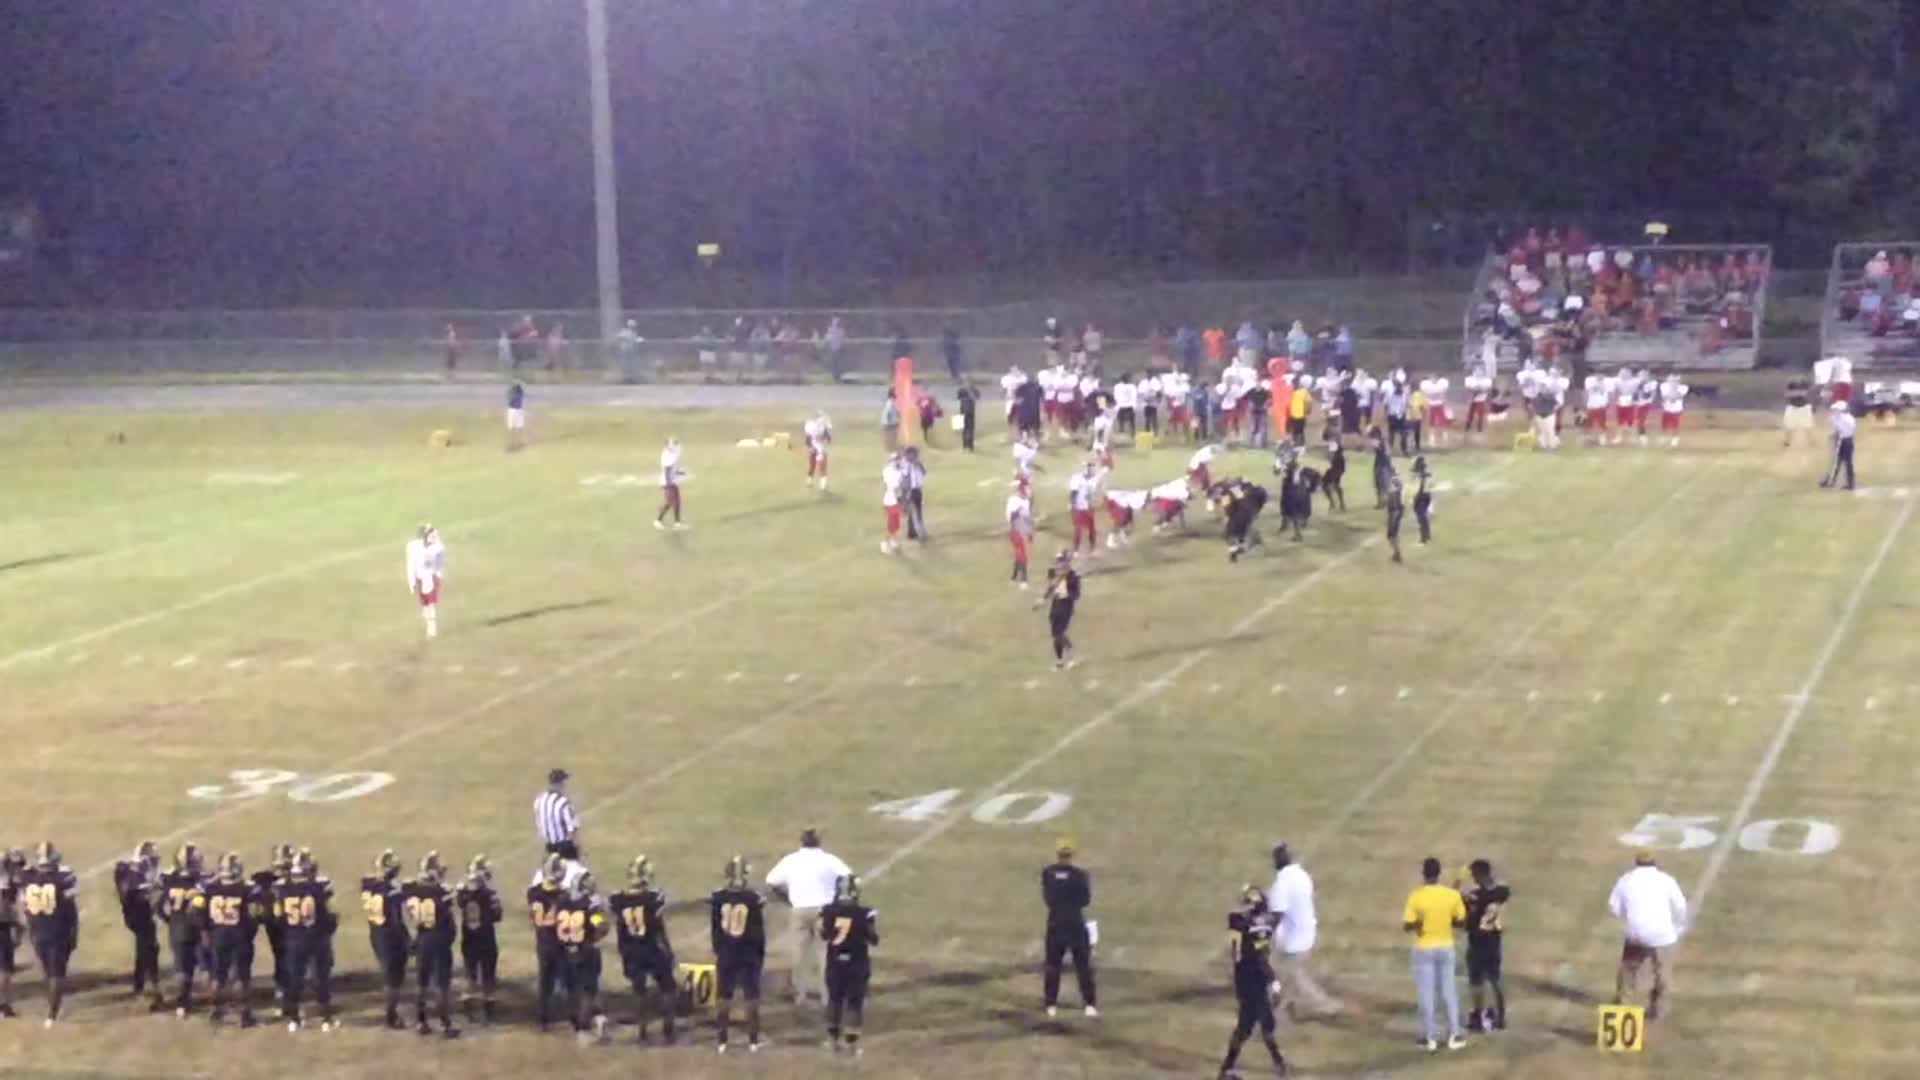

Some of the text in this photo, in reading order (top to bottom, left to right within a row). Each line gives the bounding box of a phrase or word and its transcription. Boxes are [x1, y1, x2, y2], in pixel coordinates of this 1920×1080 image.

[186, 768, 397, 802] 30
[867, 789, 1073, 825] 40
[1615, 812, 1842, 855] 50
[832, 916, 852, 944] 7
[1603, 1011, 1637, 1048] 50
